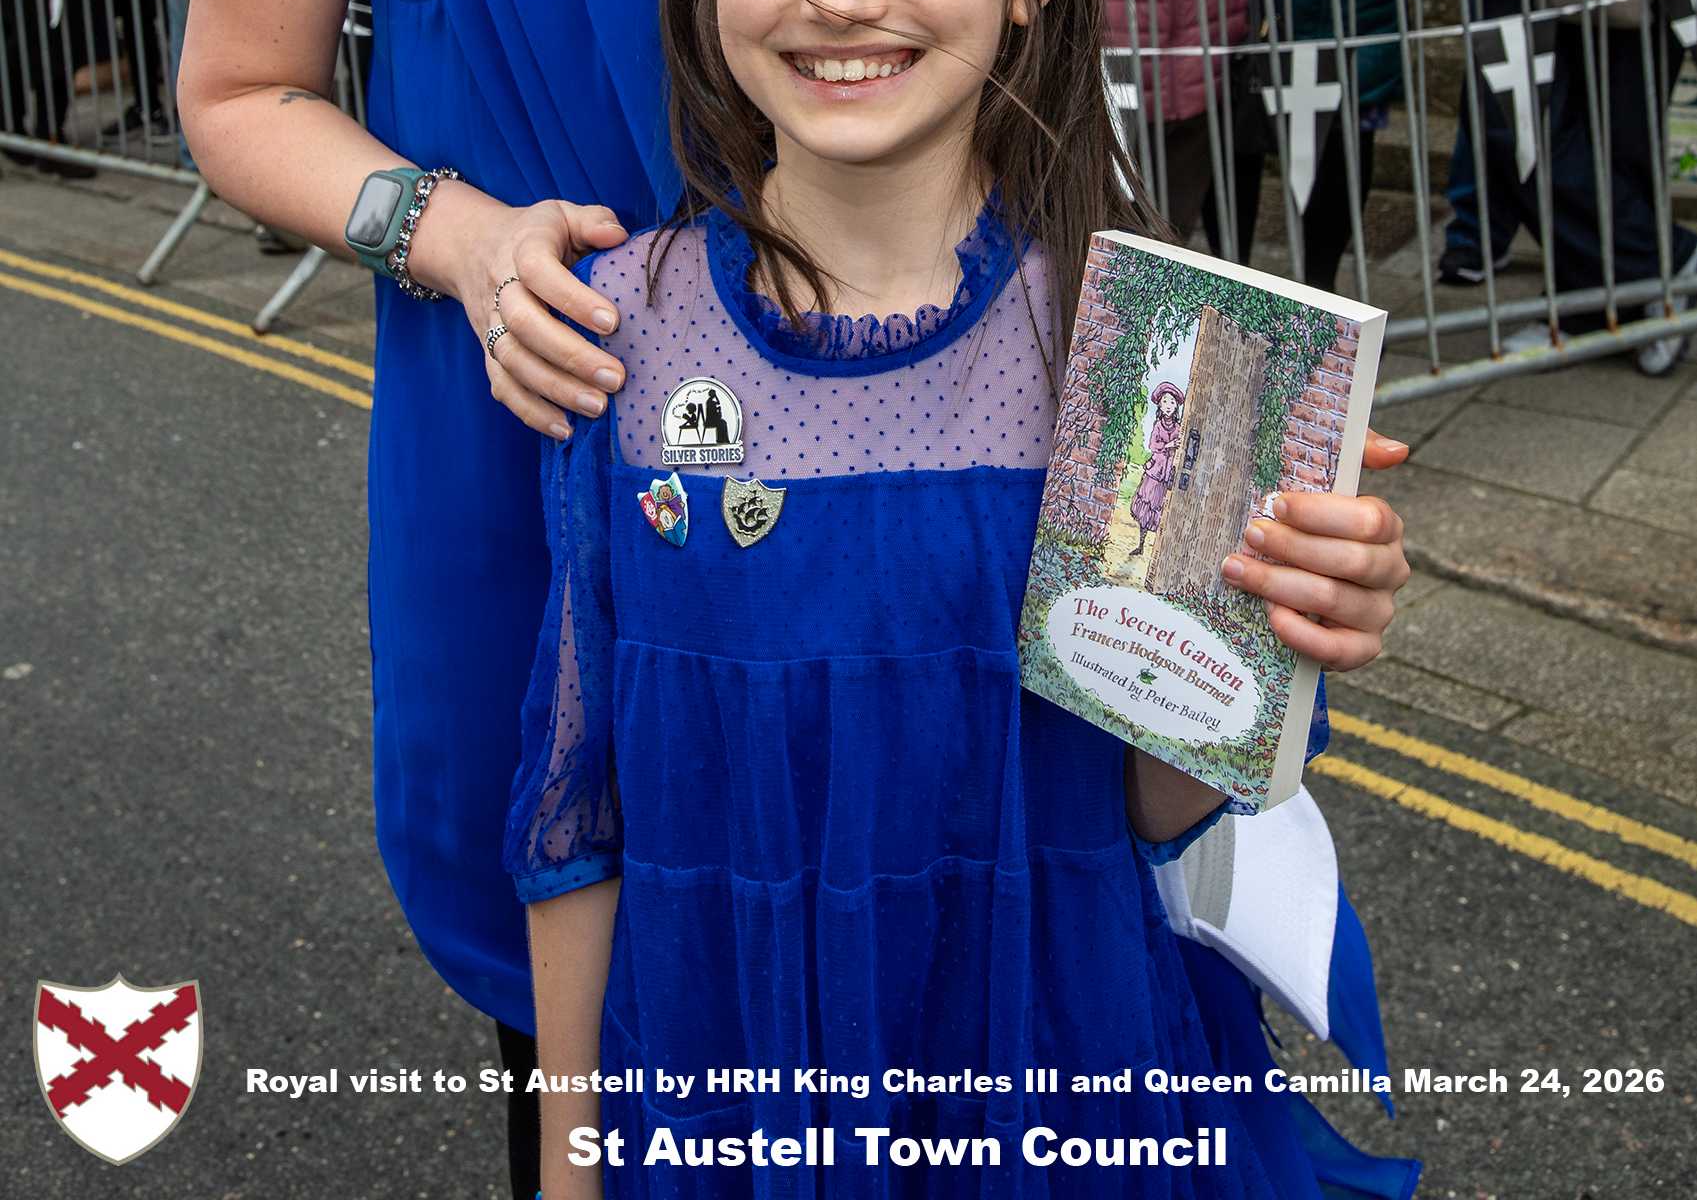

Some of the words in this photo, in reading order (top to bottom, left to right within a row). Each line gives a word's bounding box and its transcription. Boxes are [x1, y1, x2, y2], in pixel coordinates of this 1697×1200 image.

[663, 449, 697, 463] SILVER
[699, 447, 742, 462] STORIES
[1071, 622, 1127, 651] Frances
[1127, 641, 1185, 678] Hodgson
[1184, 669, 1238, 707] Burnett
[1074, 598, 1109, 620] The
[1115, 607, 1177, 647] Secret
[1180, 639, 1245, 692] Garden
[1070, 651, 1129, 689] Illustrated
[1128, 681, 1143, 701] by
[1144, 689, 1179, 712] Peter
[1179, 705, 1222, 733] Bailey
